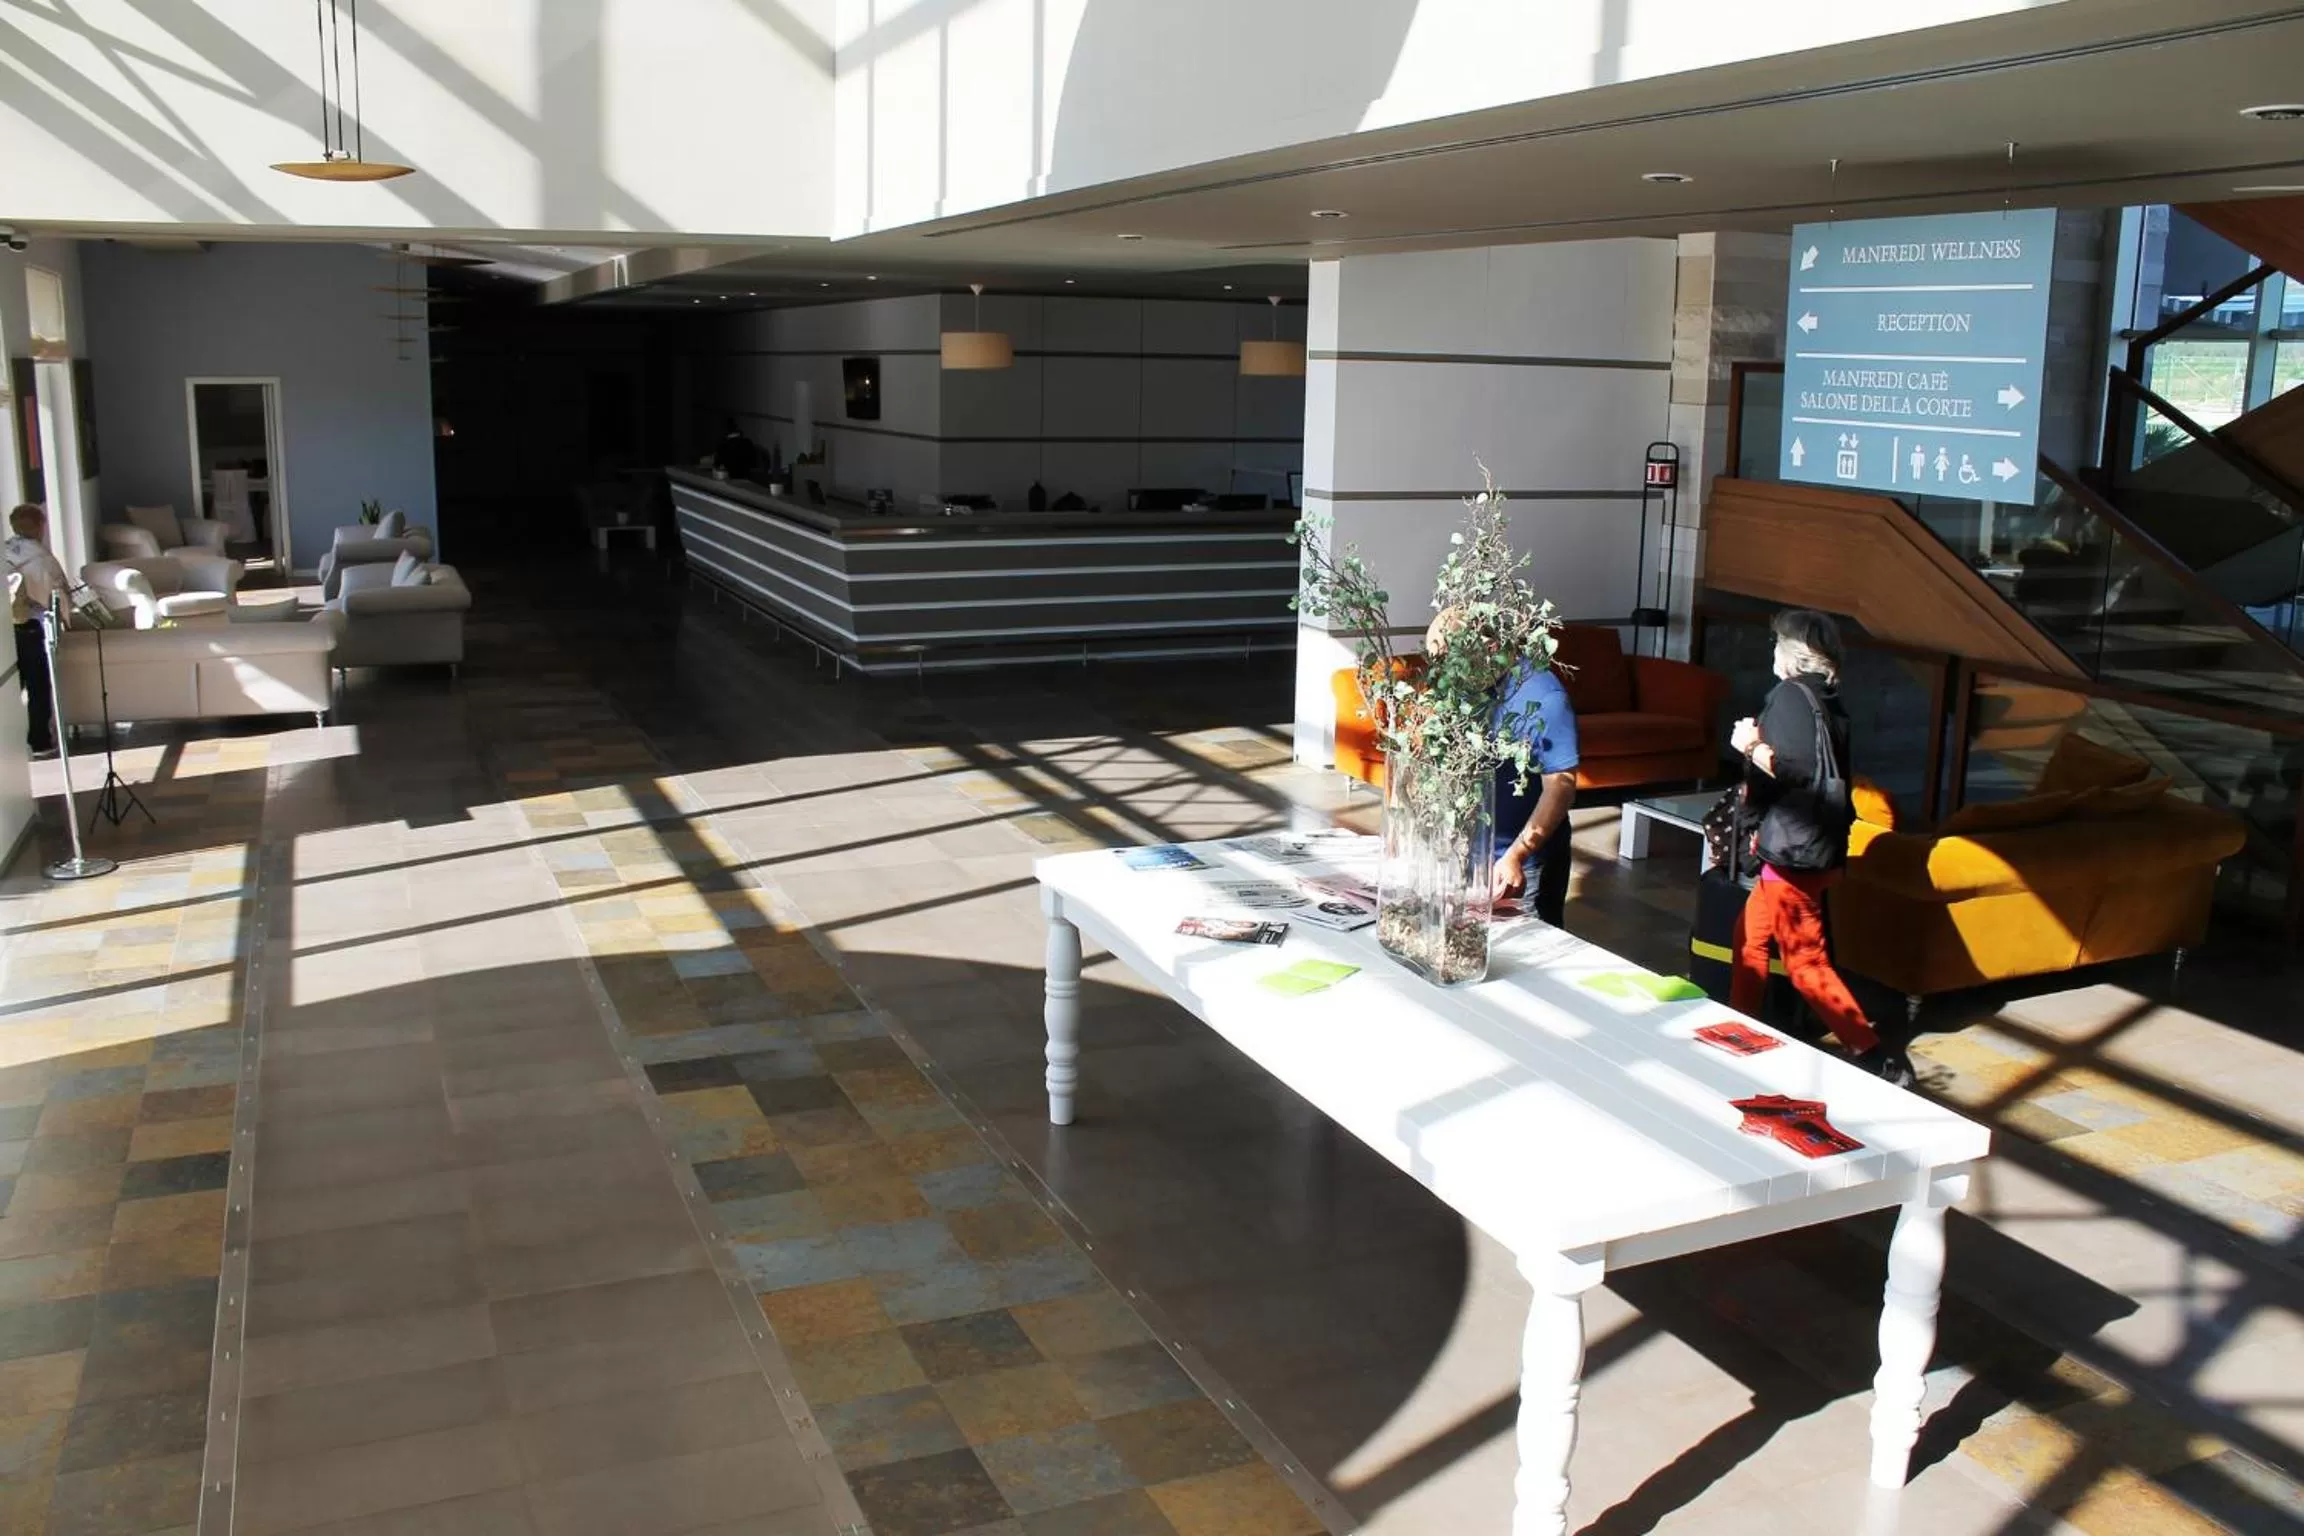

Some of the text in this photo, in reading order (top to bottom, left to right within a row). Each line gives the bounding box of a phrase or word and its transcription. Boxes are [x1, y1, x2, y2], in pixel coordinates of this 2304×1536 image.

[1842, 239, 2022, 264] MANFREDI WELLNESS
[1877, 313, 1971, 332] RECEPTION
[1822, 369, 1902, 389] MANFREDI
[1800, 391, 1973, 418] SALONE DELLA CORTE
